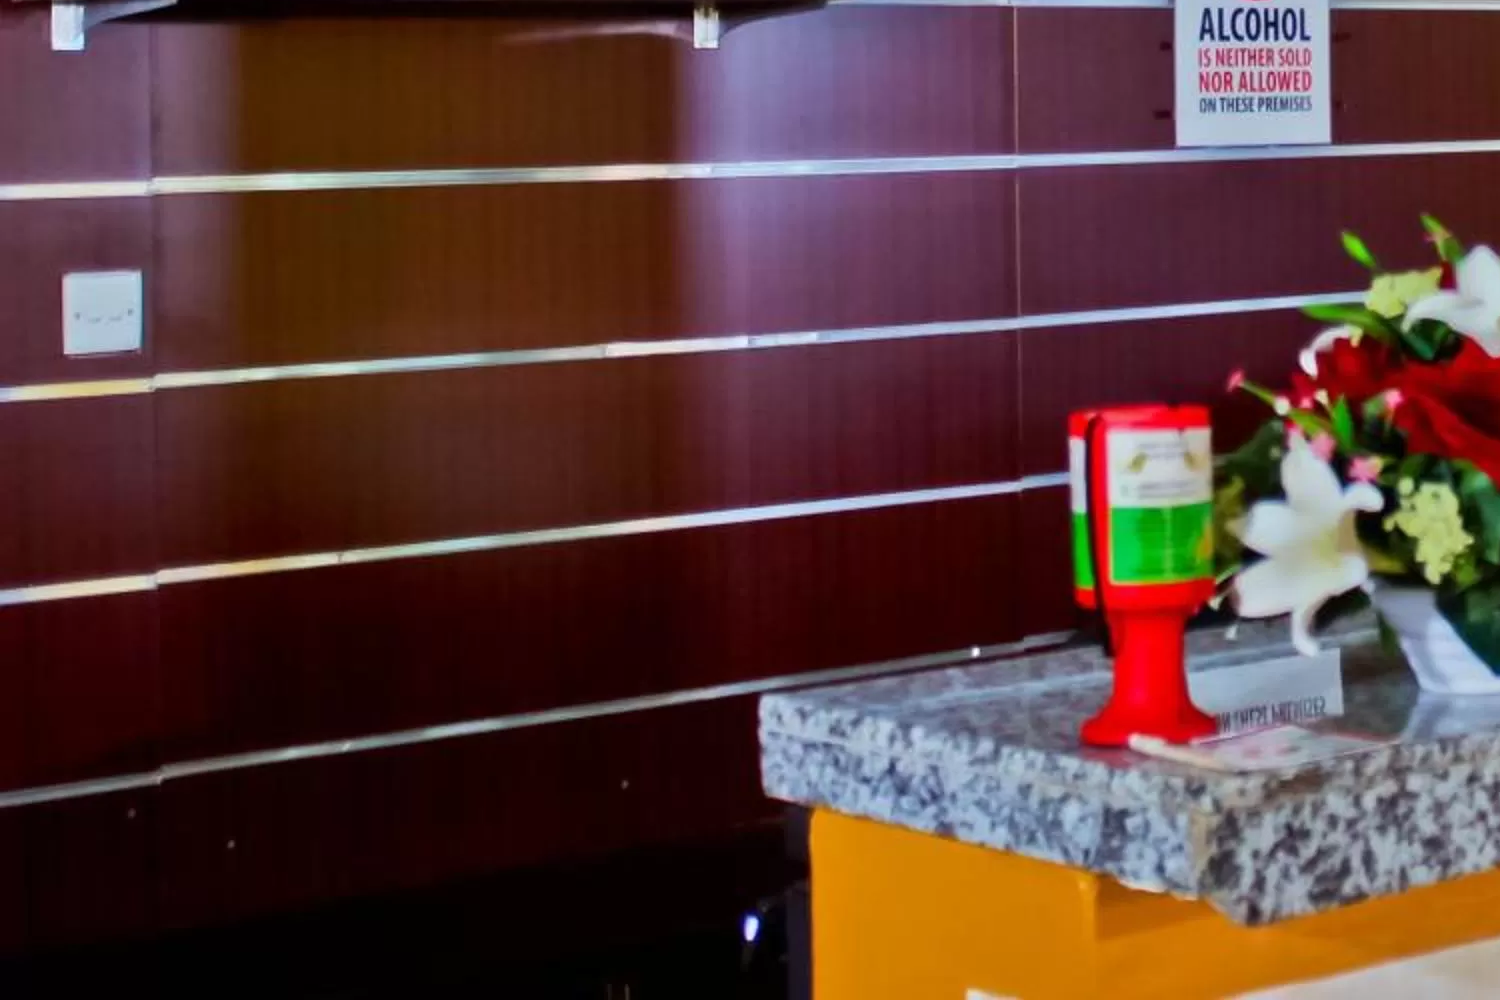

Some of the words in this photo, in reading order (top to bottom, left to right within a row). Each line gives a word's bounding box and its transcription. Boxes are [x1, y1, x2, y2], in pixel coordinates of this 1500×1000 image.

[1199, 7, 1311, 42] ALCOHOL
[1198, 48, 1211, 67] IS
[1215, 48, 1275, 67] NEITHER
[1278, 47, 1312, 67] SOLD
[1199, 71, 1233, 93] NOR
[1238, 71, 1312, 92] ALLOWED
[1199, 97, 1216, 113] ON
[1219, 96, 1255, 113] THESE
[1258, 95, 1312, 112] PREMISES
